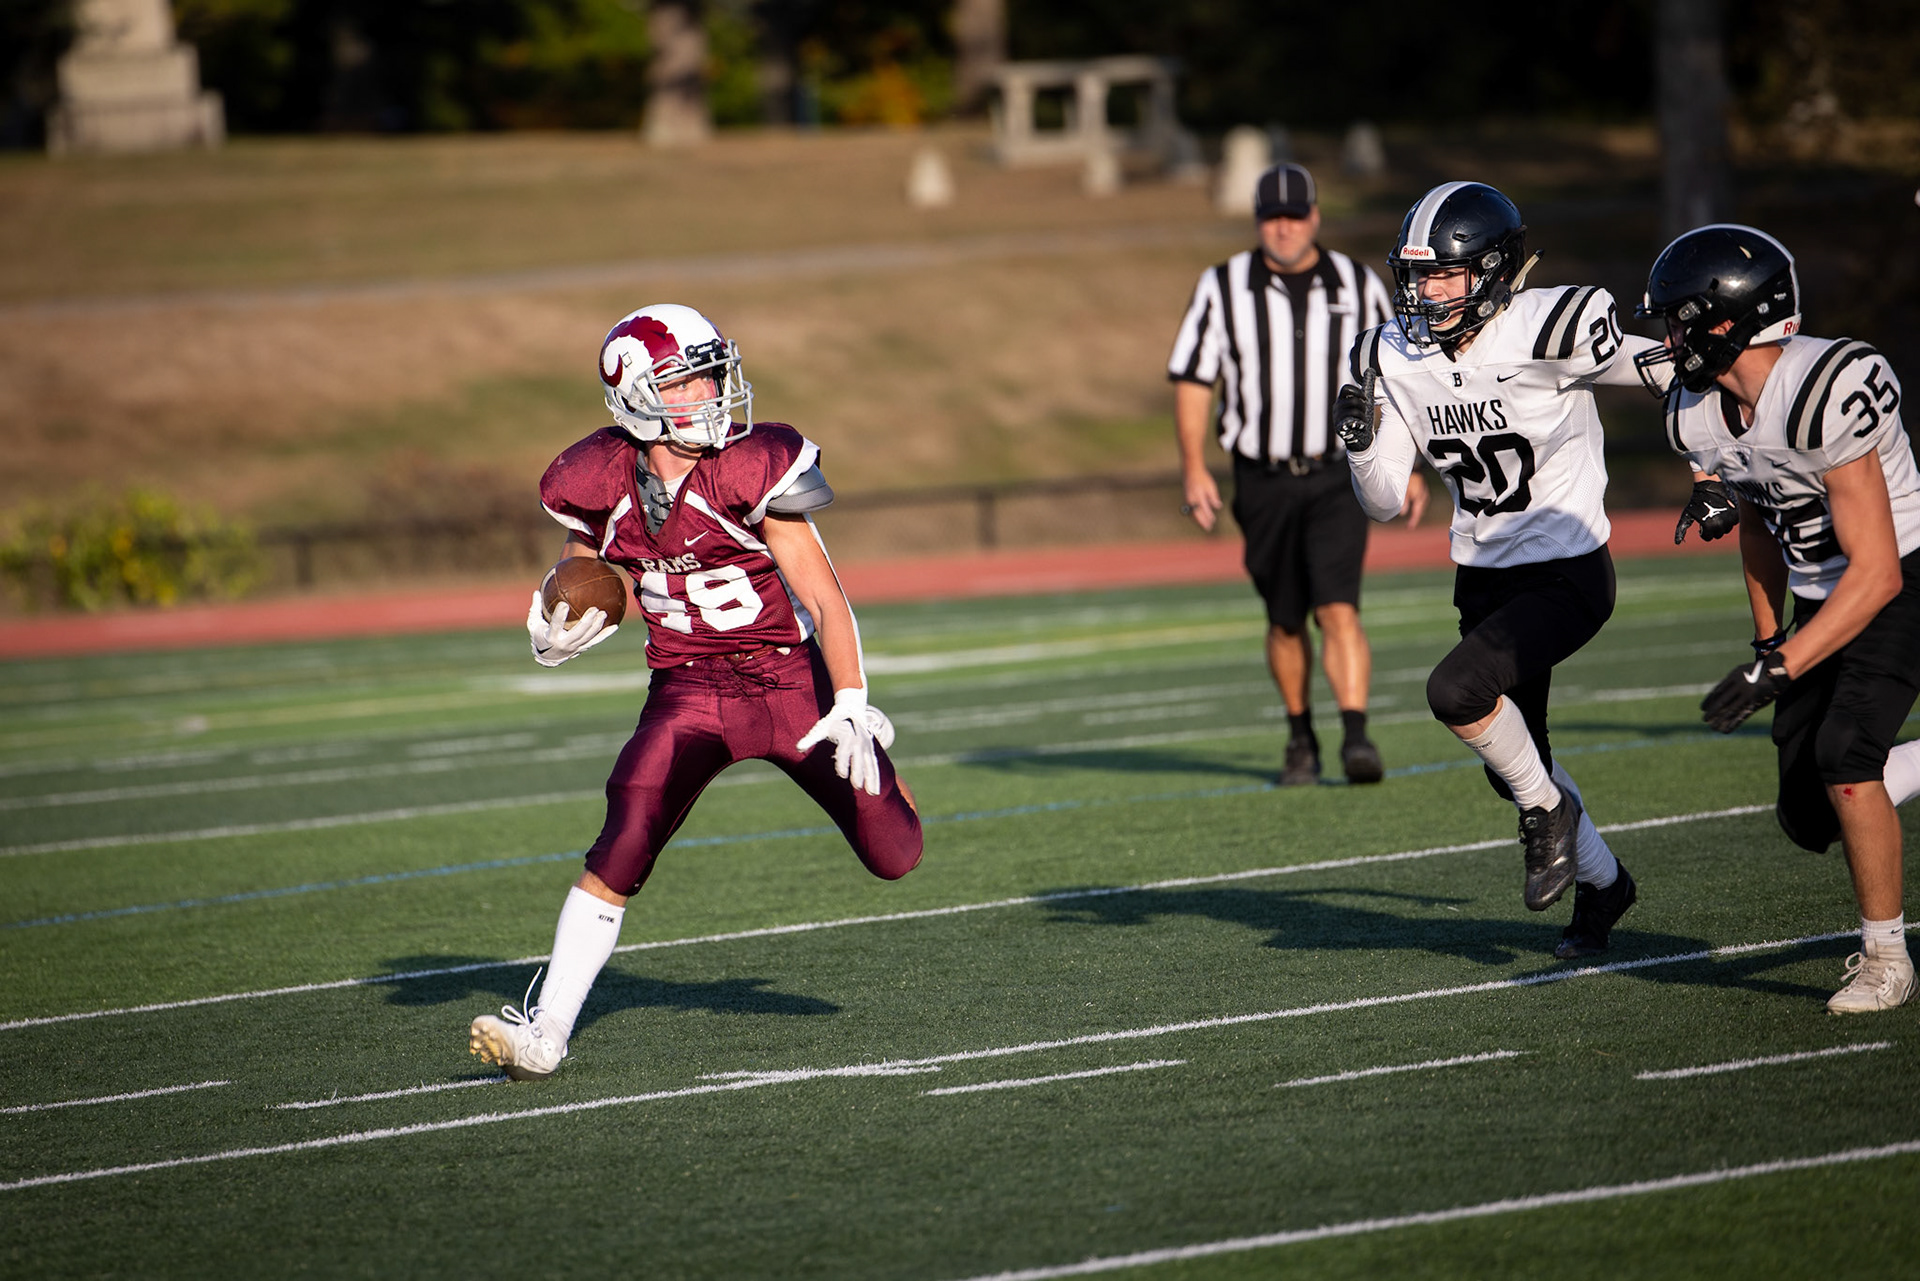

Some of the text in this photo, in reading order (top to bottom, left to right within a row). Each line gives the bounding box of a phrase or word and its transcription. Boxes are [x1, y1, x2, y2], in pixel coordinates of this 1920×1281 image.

[1403, 246, 1430, 257] Riddell
[1452, 372, 1463, 388] B
[1841, 362, 1899, 438] 35
[1427, 399, 1508, 435] HAWKS
[1427, 432, 1536, 519] 20
[637, 552, 702, 574] RAMS
